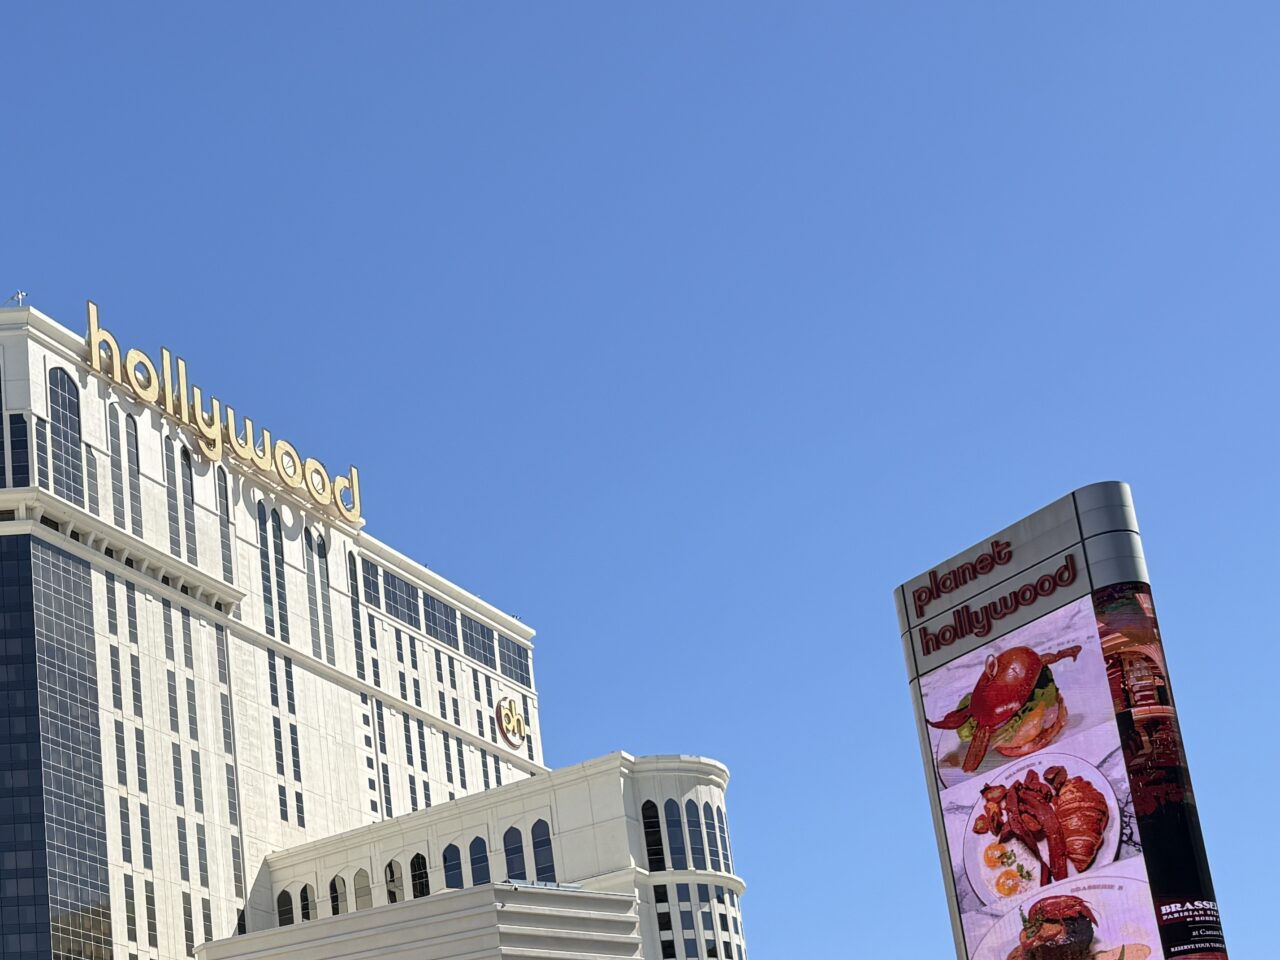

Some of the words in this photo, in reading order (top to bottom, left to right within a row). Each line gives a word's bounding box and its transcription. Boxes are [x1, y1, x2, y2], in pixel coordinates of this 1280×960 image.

[87, 299, 362, 523] hollywood
[912, 539, 1013, 619] planet
[919, 553, 1077, 656] hollywood
[500, 699, 526, 741] ph
